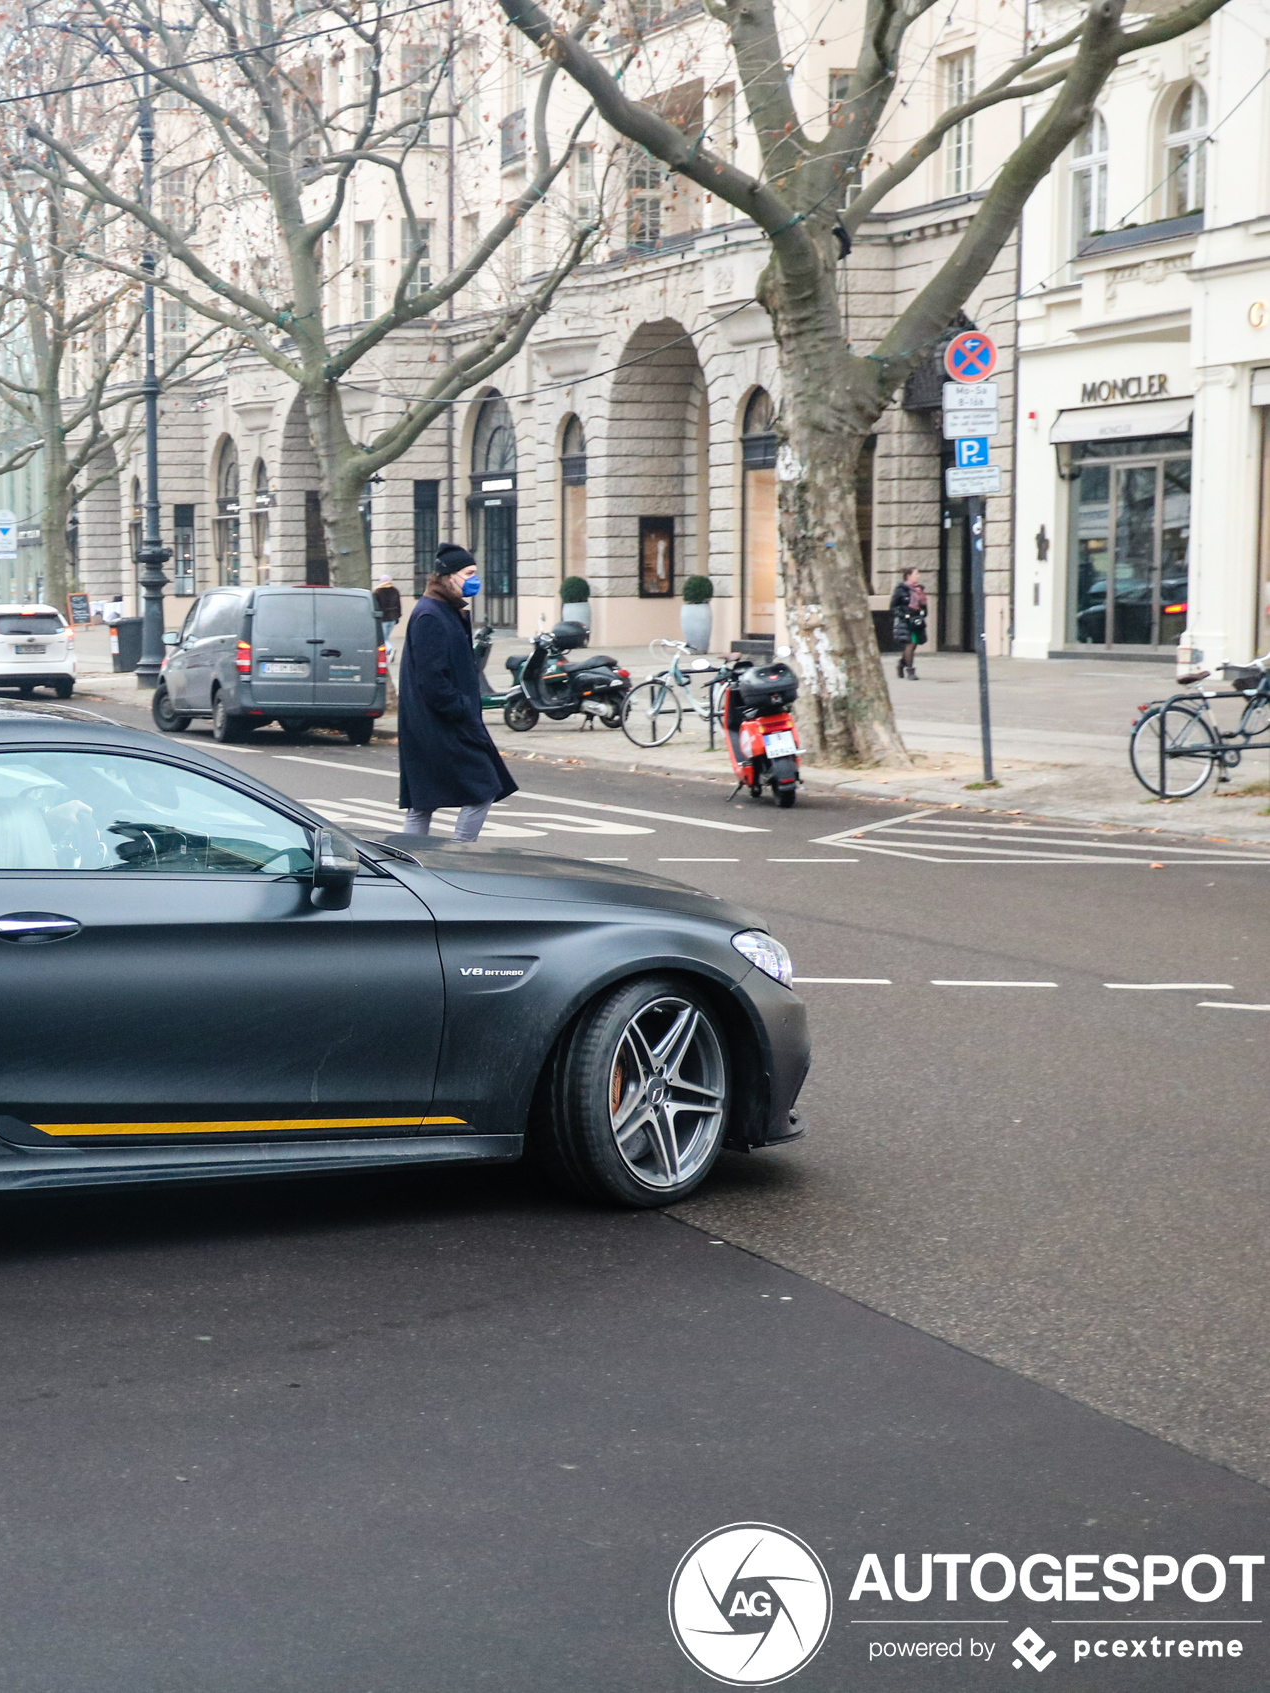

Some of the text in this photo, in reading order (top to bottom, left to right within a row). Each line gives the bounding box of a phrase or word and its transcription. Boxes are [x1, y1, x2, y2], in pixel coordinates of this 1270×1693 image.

[1080, 373, 1169, 404] MONCLER
[960, 440, 980, 465] P
[459, 967, 484, 976] V8
